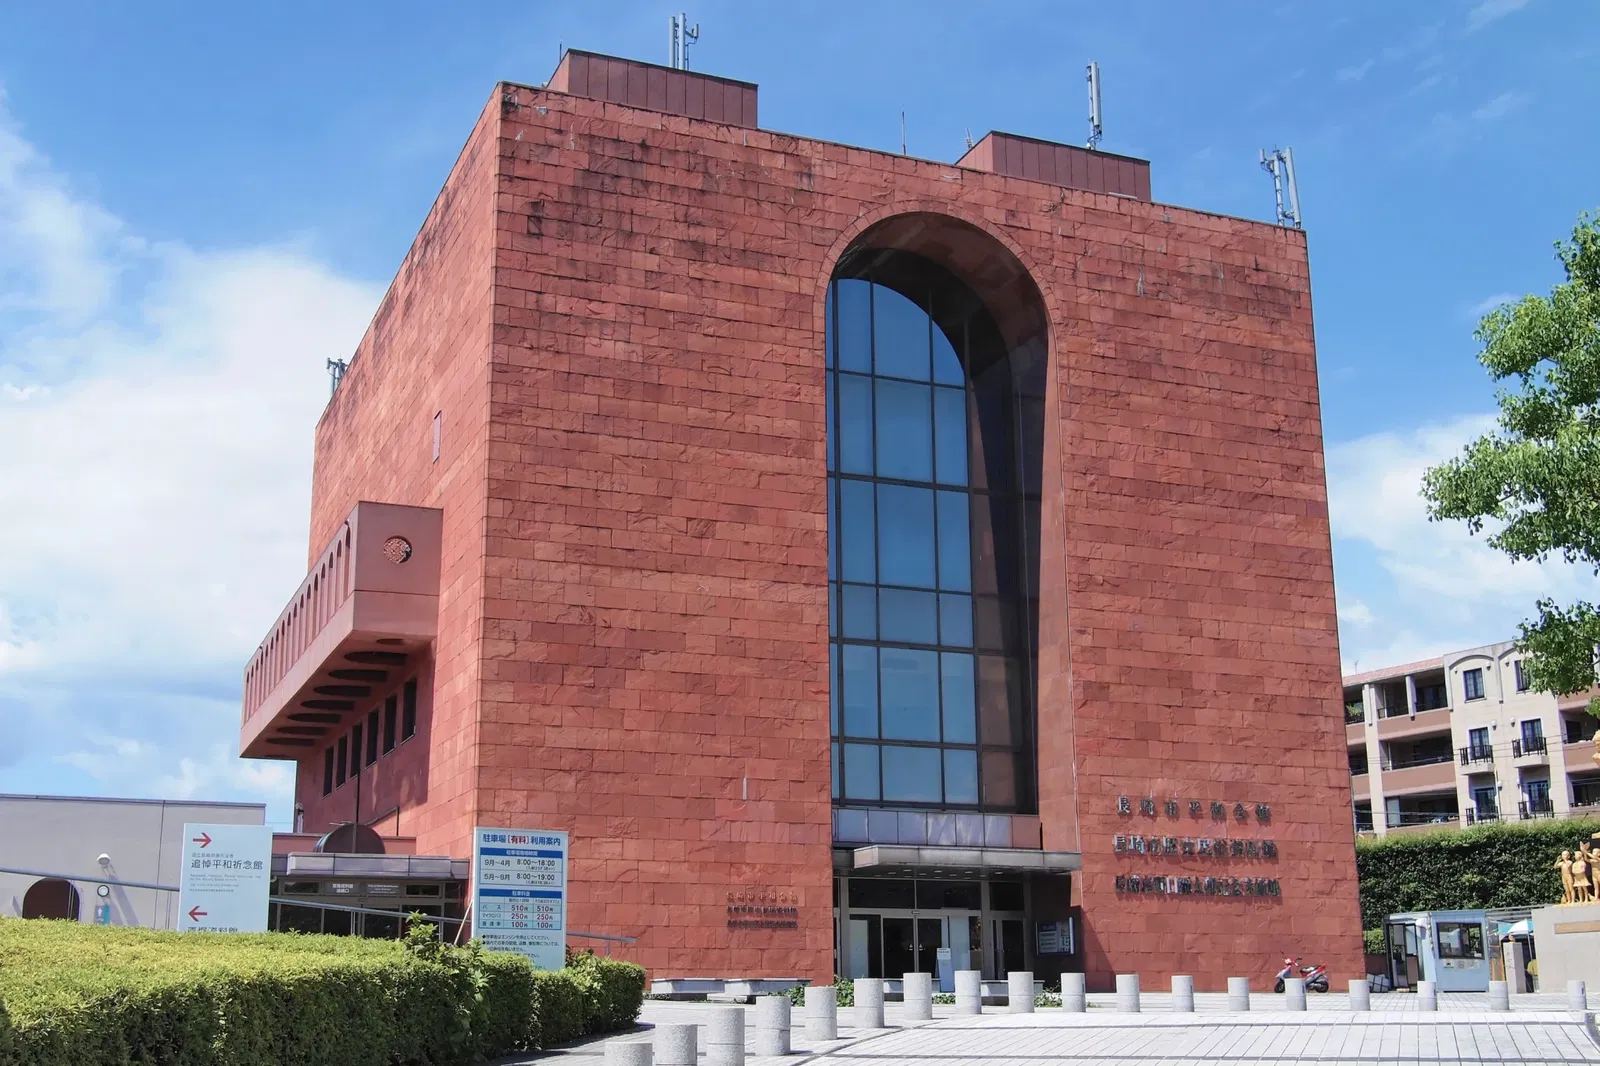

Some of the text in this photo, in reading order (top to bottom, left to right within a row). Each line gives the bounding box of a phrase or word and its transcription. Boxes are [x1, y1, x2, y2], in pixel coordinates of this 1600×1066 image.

[190, 859, 263, 870] 追悼平和祈念館
